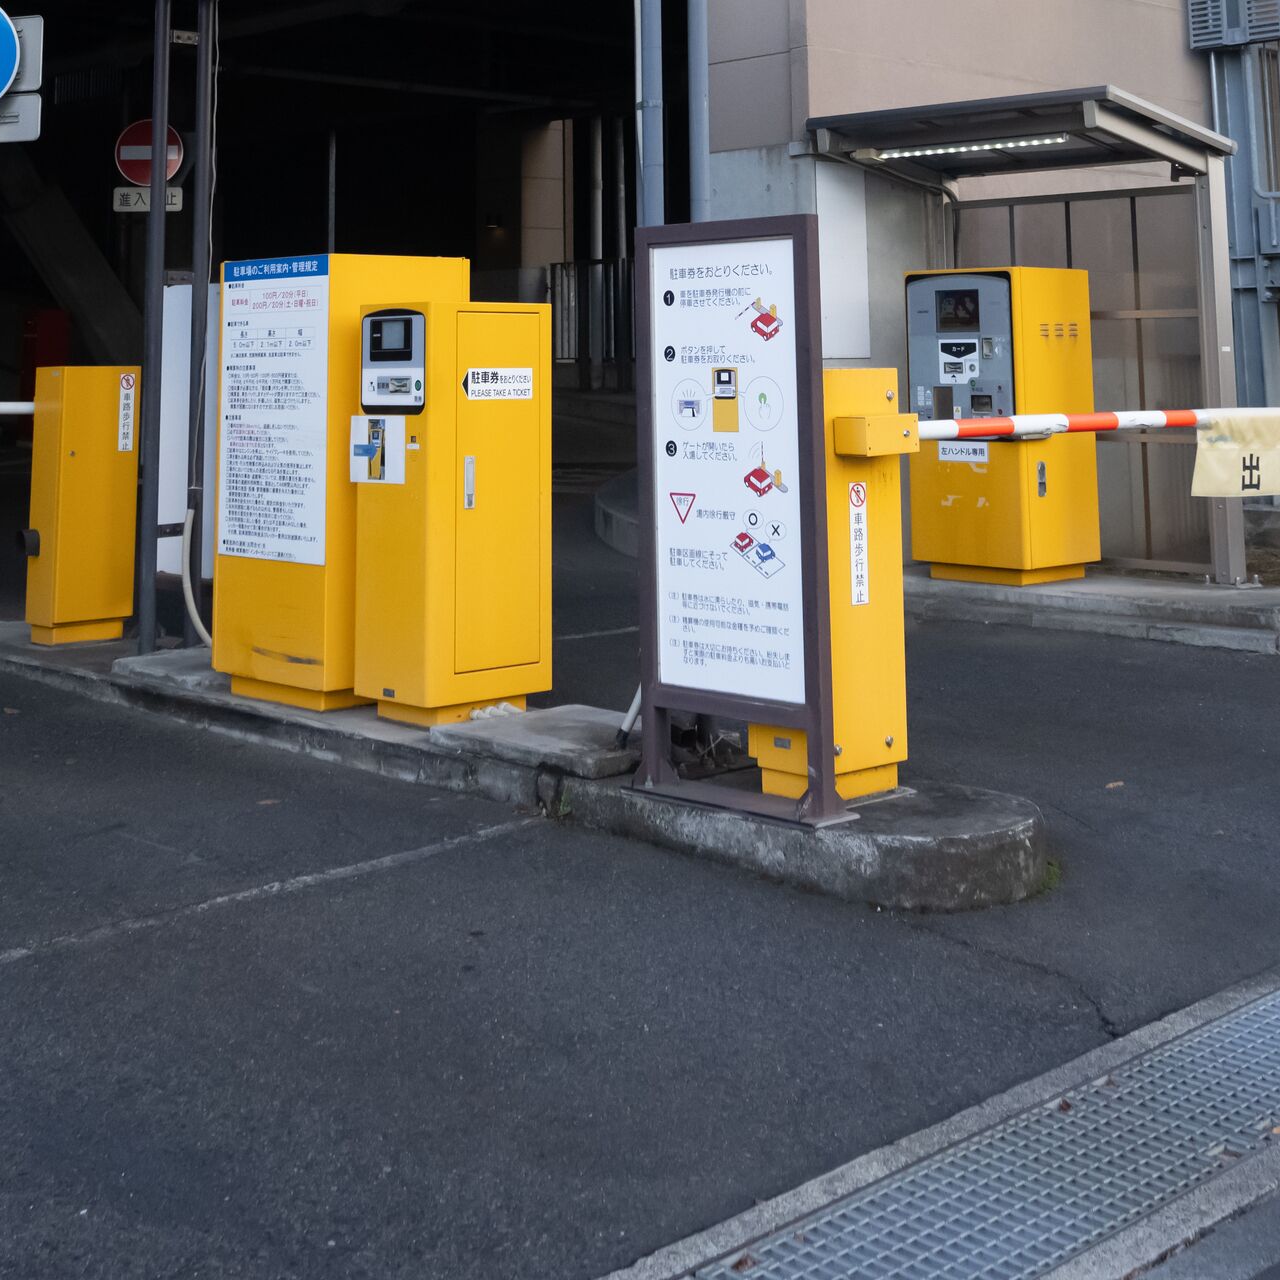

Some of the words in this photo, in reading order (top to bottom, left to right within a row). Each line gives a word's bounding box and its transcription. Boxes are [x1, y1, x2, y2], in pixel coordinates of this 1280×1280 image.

[119, 192, 177, 206] 進入止
[669, 264, 773, 280] 駐車券をおとりください。
[680, 345, 726, 355] ボタンを押して
[471, 389, 491, 397] PLEASE
[513, 388, 531, 396] TICKET
[941, 447, 985, 457] 左ハンドル専用
[854, 512, 865, 604] 車路歩行禁止
